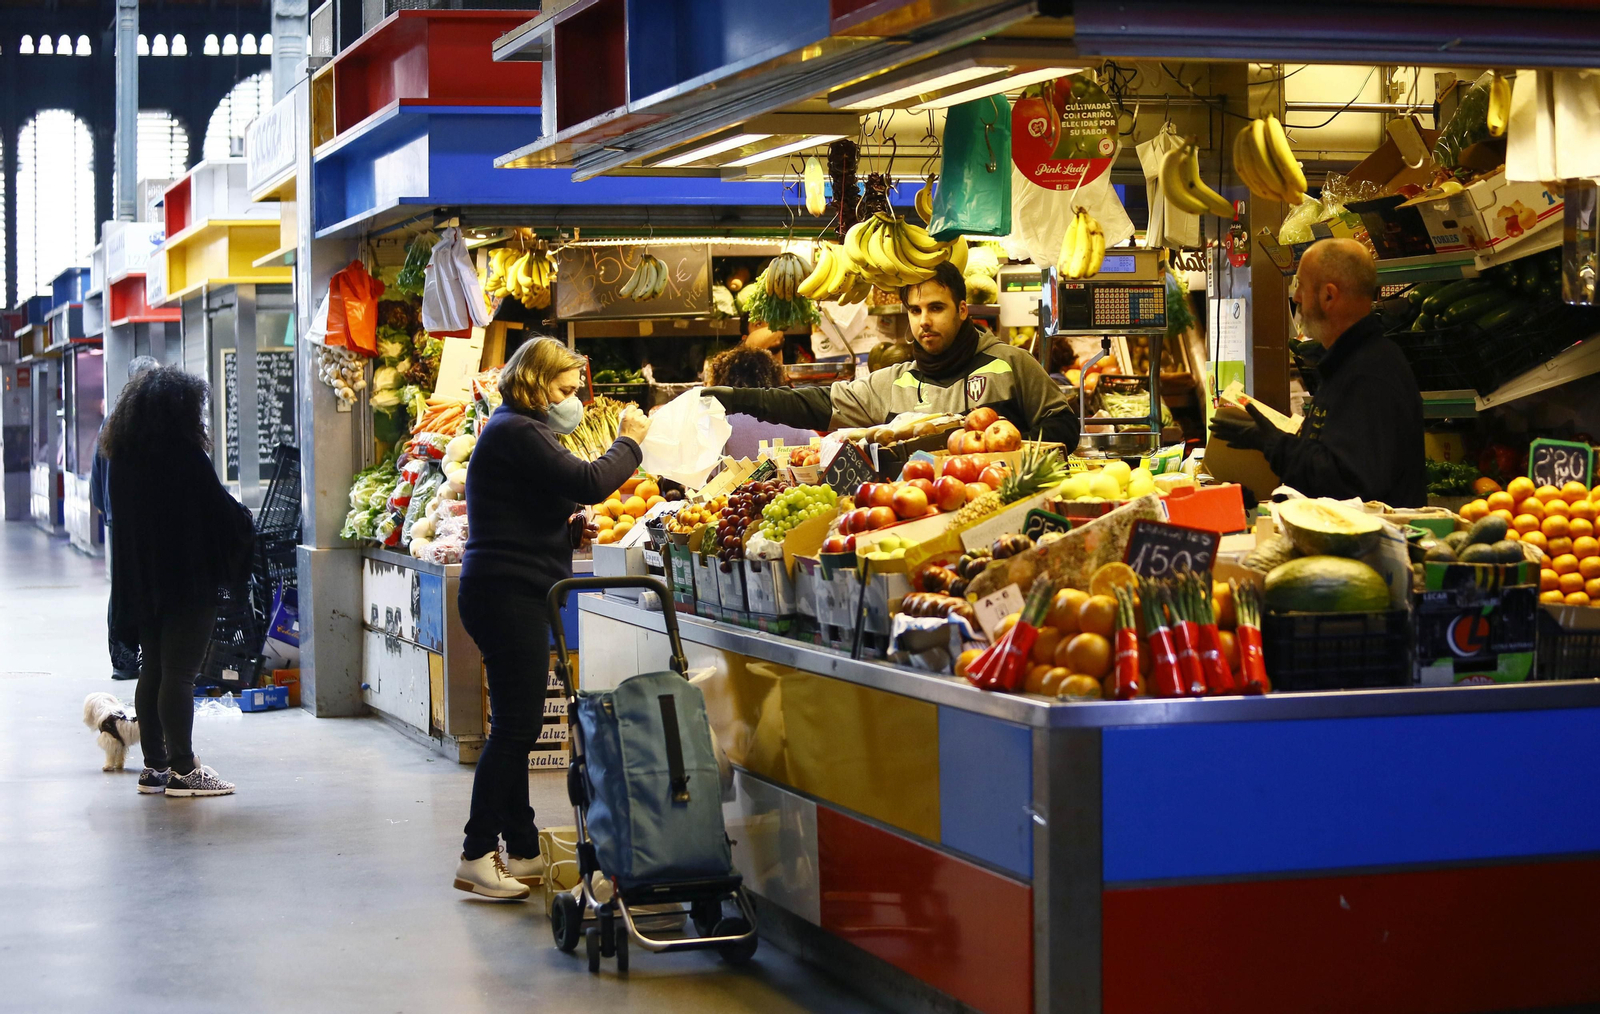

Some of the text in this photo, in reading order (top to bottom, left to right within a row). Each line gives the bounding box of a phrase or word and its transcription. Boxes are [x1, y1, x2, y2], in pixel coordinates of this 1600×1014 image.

[1065, 102, 1111, 111] CULTIVADAS
[1081, 110, 1114, 119] CARIÑO,
[1035, 162, 1087, 176] Pink Lady
[1432, 234, 1460, 245] TORRES
